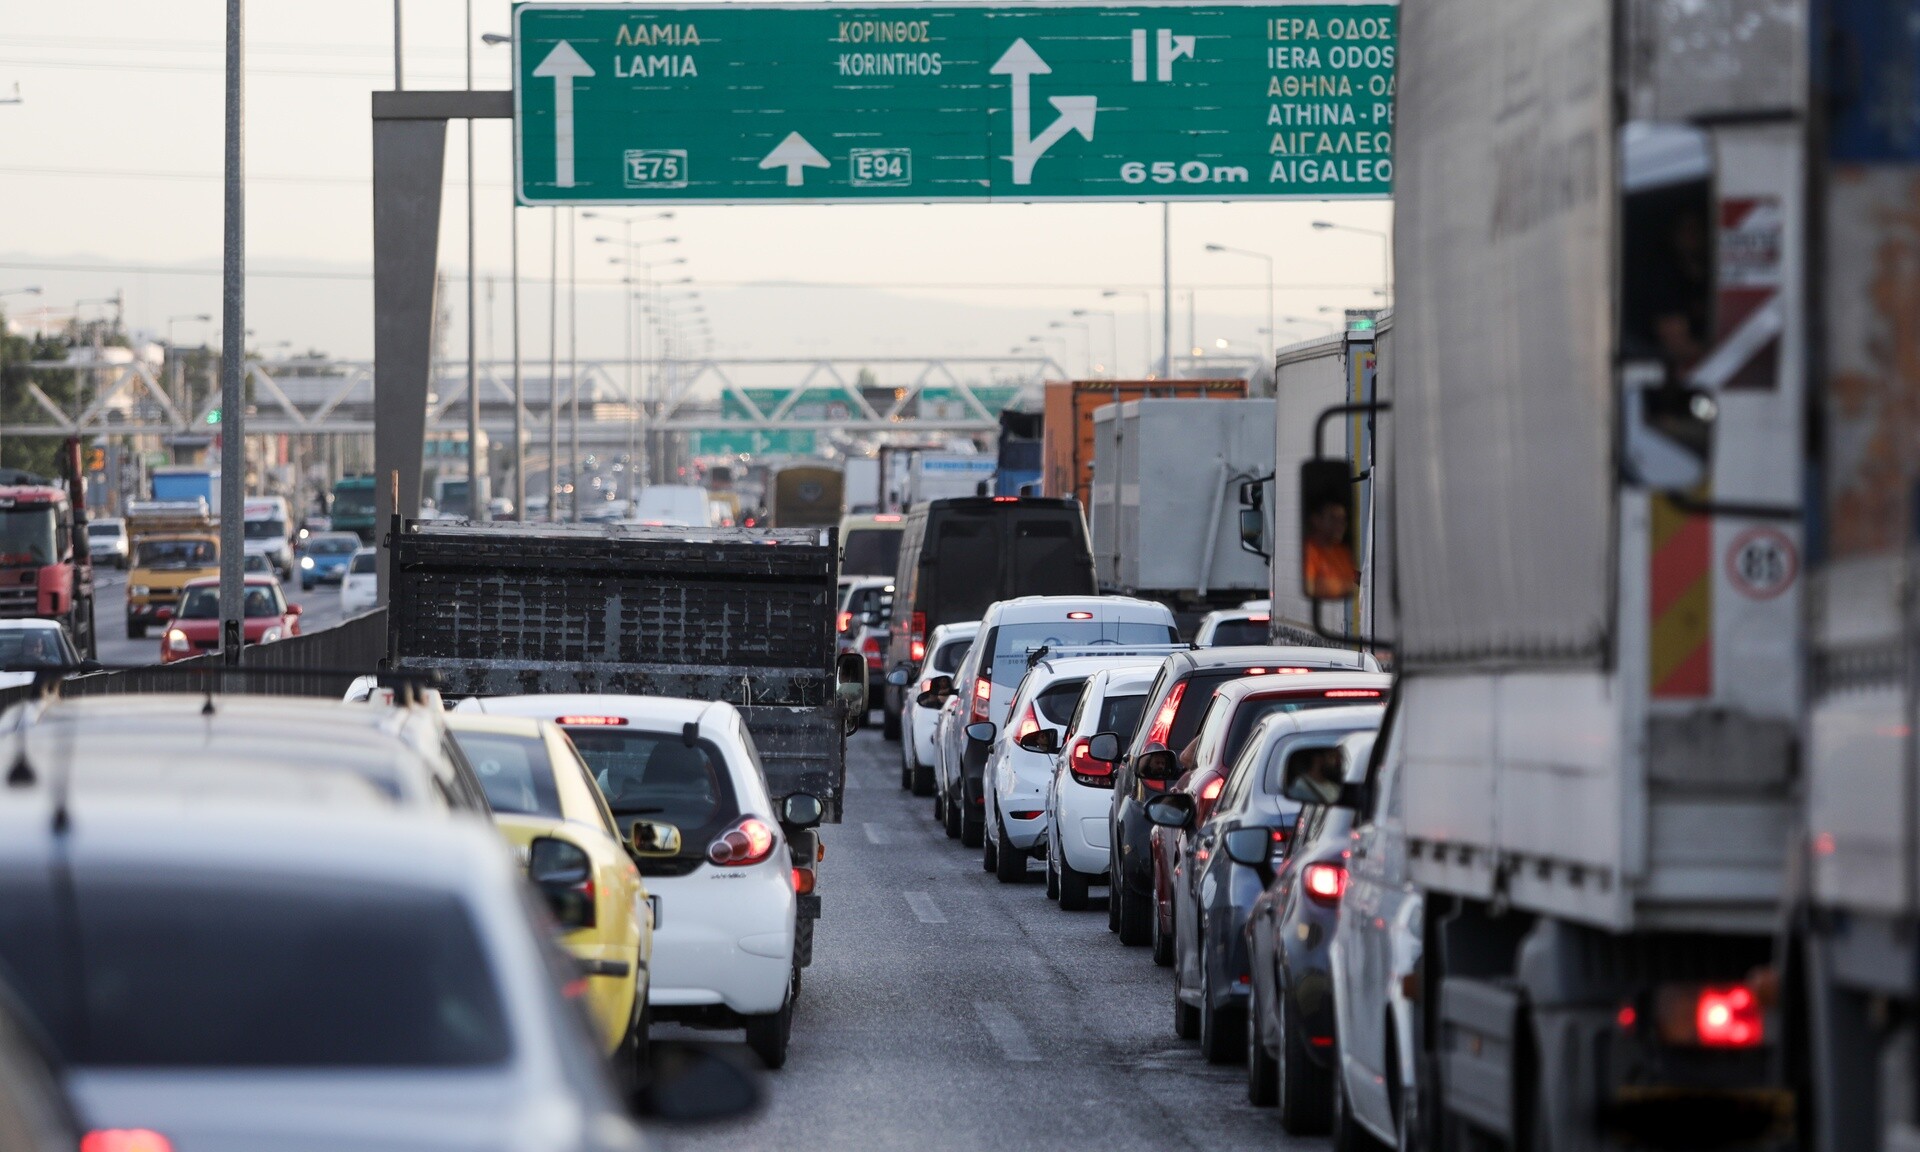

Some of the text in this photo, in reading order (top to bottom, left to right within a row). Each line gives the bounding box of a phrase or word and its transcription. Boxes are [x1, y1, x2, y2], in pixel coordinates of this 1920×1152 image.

[615, 23, 700, 46] ΛΑΜΙΑ
[839, 20, 930, 43] ΚΟΡΙΝΘΟΣ
[1267, 17, 1391, 40] ΙΕΡΑ ΟΔΟΣ
[614, 54, 698, 78] LAMIA
[839, 52, 942, 76] KORINTHOS
[1267, 45, 1395, 69] IERA ODOS
[1267, 75, 1353, 97] ΑΘΗΝΑ
[1267, 103, 1356, 125] ATHINA
[1269, 131, 1392, 155] ΑΙΓΑΛΕΩ
[629, 157, 678, 180] E75
[857, 156, 903, 179] E94
[1120, 160, 1249, 184] 650m
[1269, 159, 1393, 183] AIGALEO
